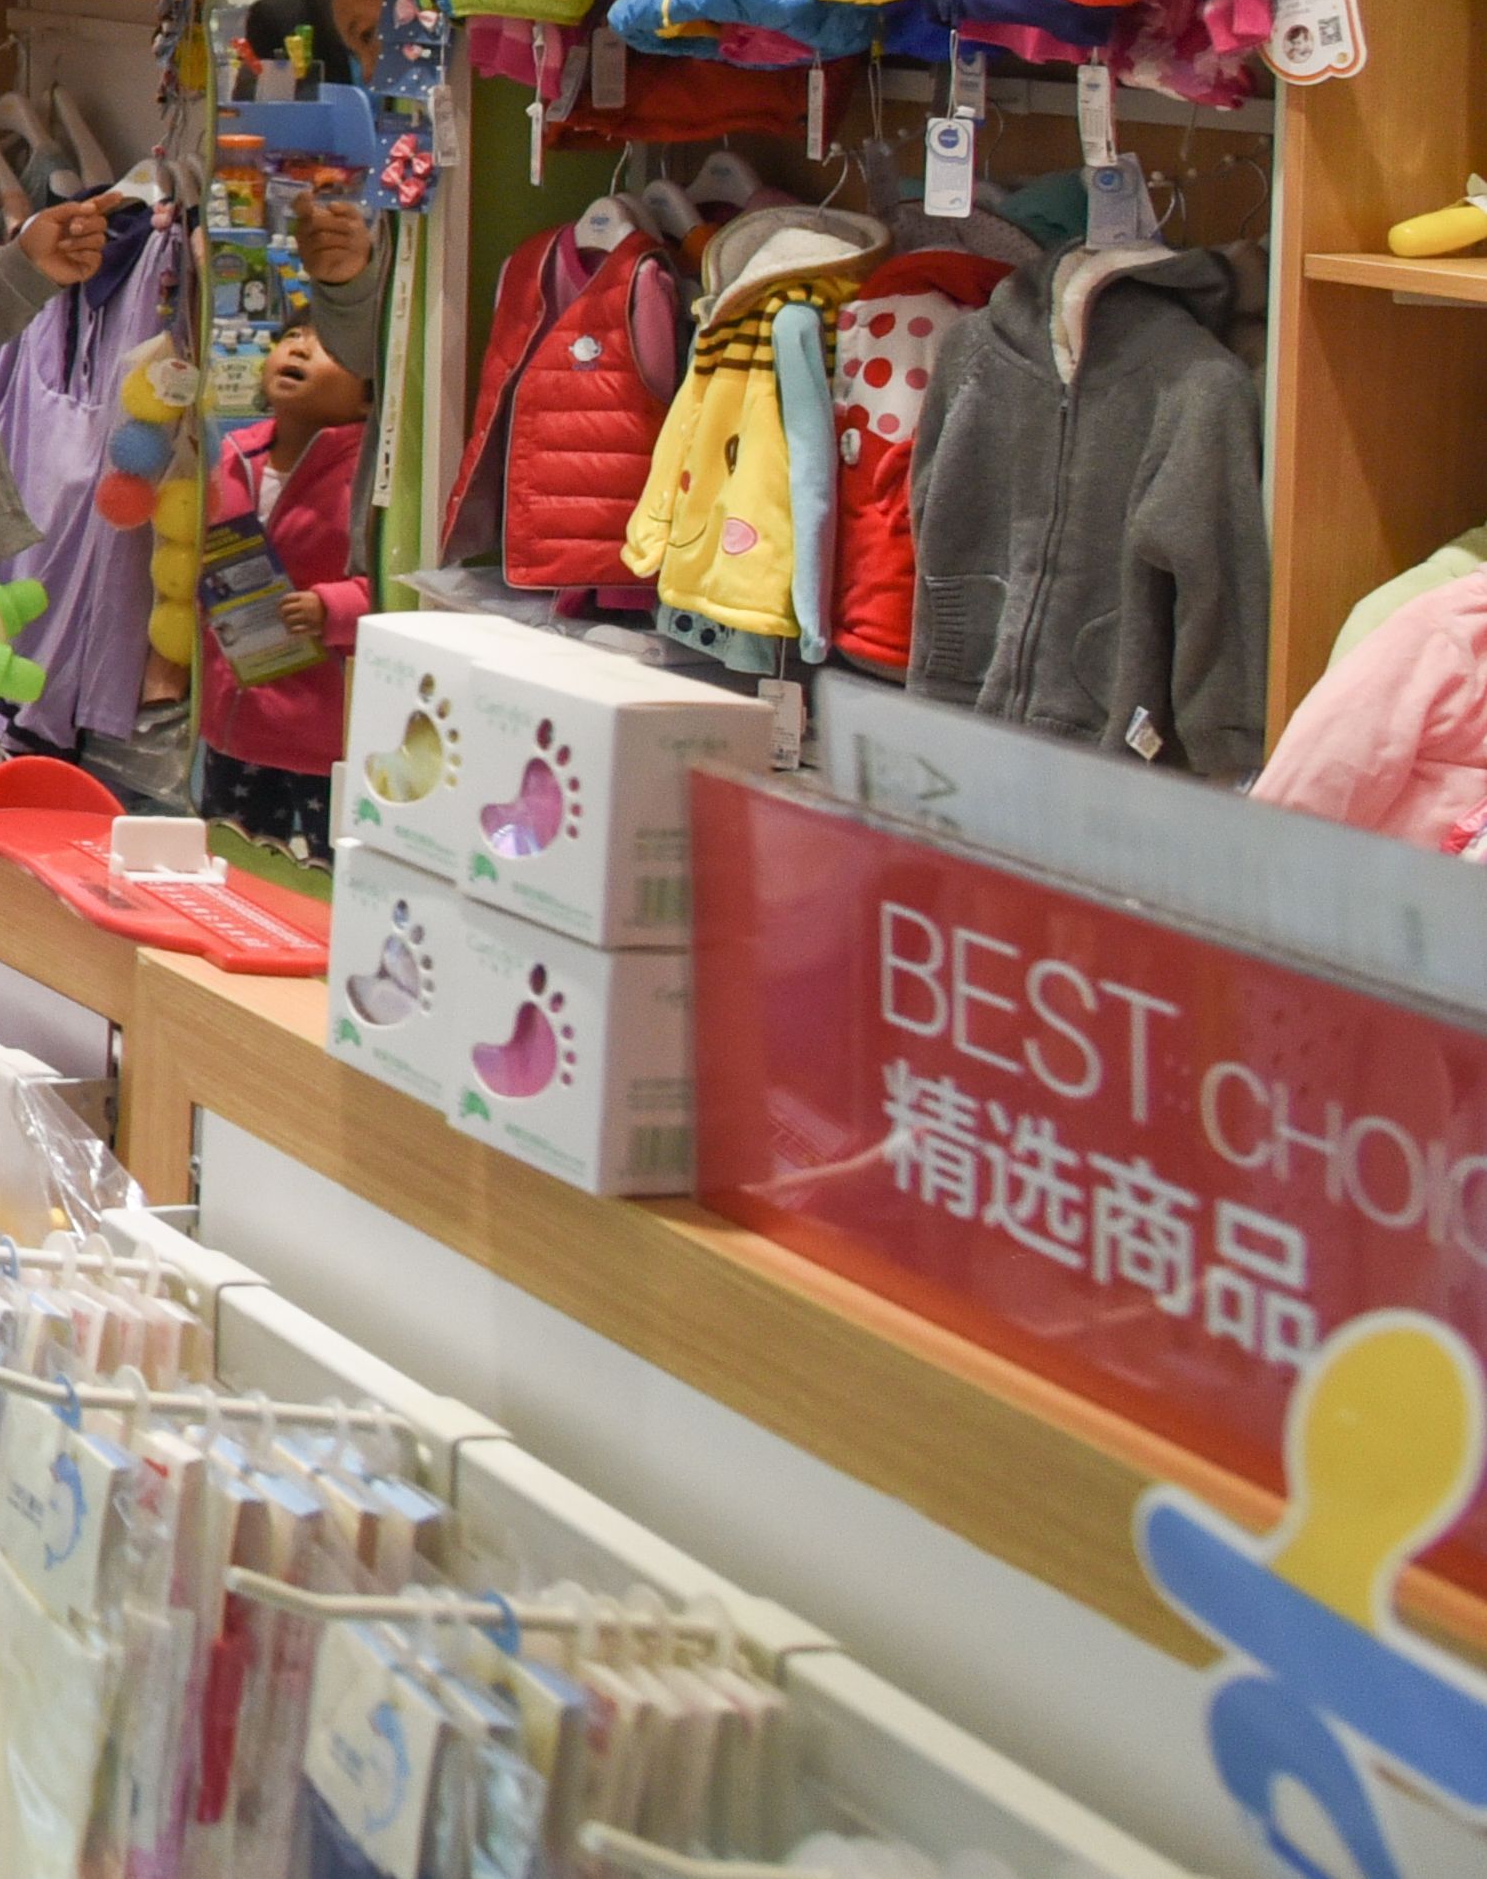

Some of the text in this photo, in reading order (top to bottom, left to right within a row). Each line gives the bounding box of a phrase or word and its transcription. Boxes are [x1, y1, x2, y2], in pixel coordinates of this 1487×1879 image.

[880, 900, 1178, 1126] BEST
[881, 1058, 1322, 1371] 精选商品
